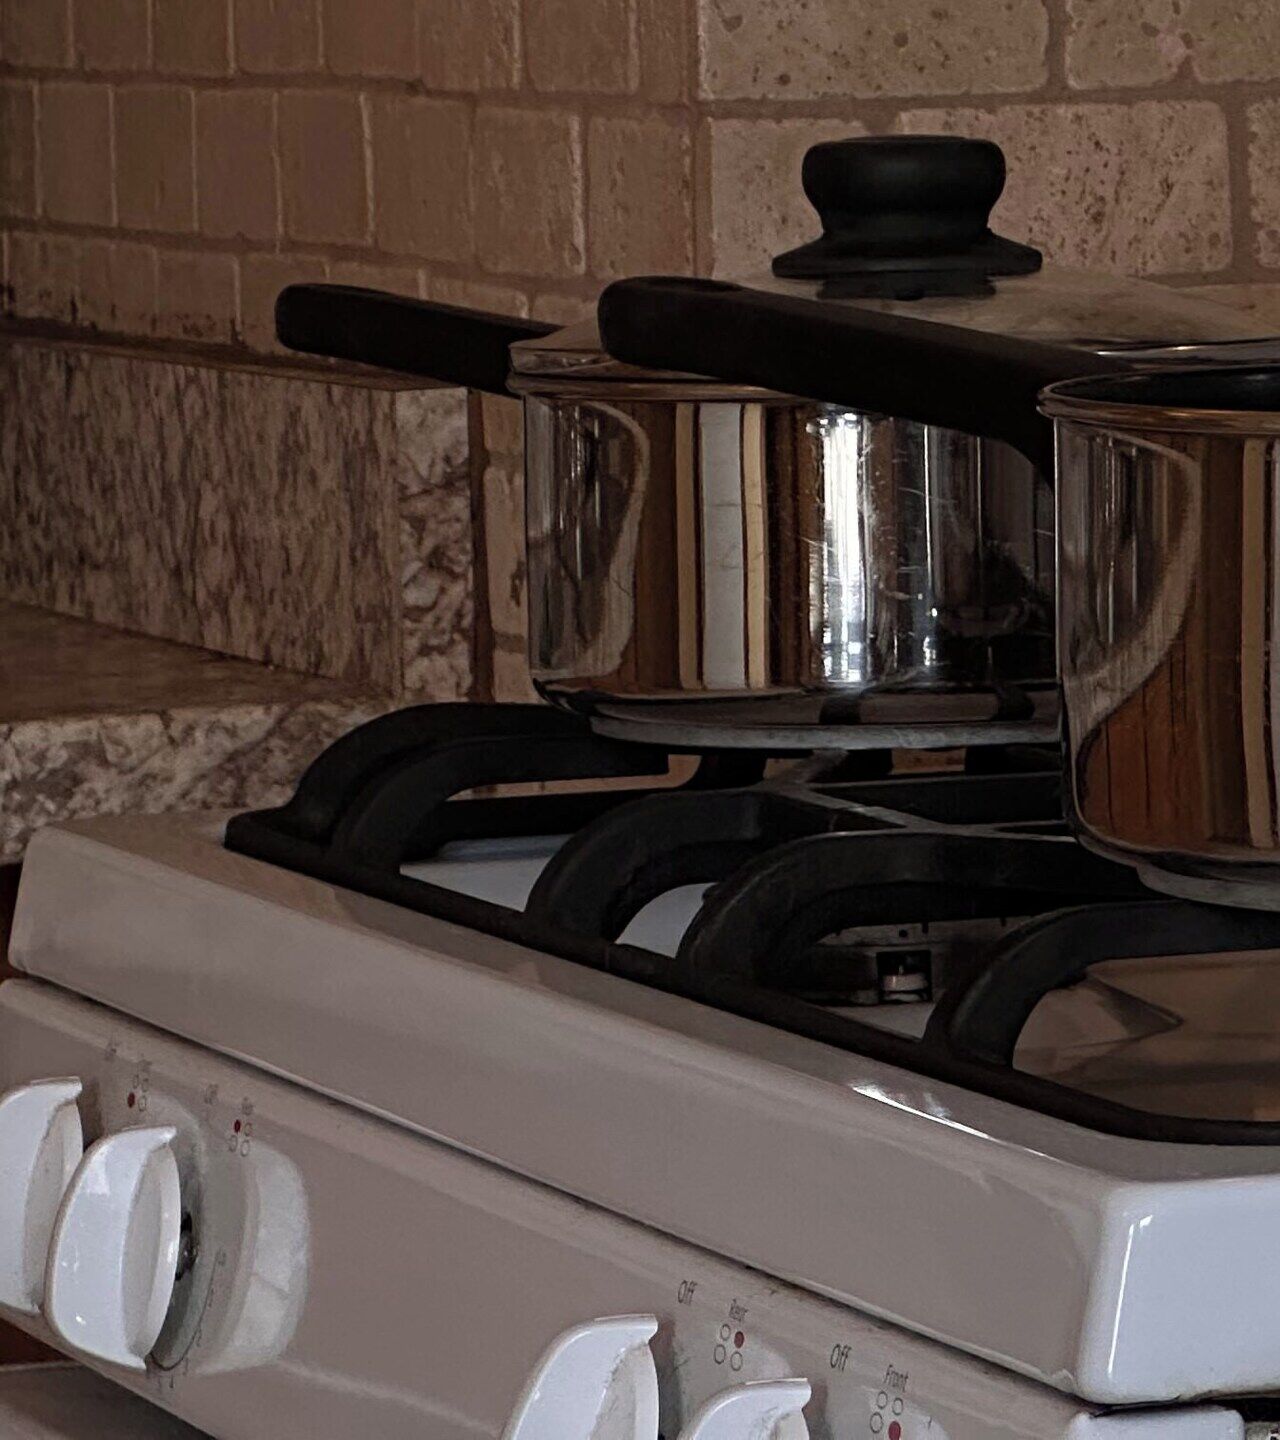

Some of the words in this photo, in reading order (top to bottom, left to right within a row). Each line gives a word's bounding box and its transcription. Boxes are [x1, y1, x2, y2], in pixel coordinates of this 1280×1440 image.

[677, 1279, 698, 1306] Off
[830, 1343, 852, 1372] Off
[883, 1364, 909, 1393] Front
